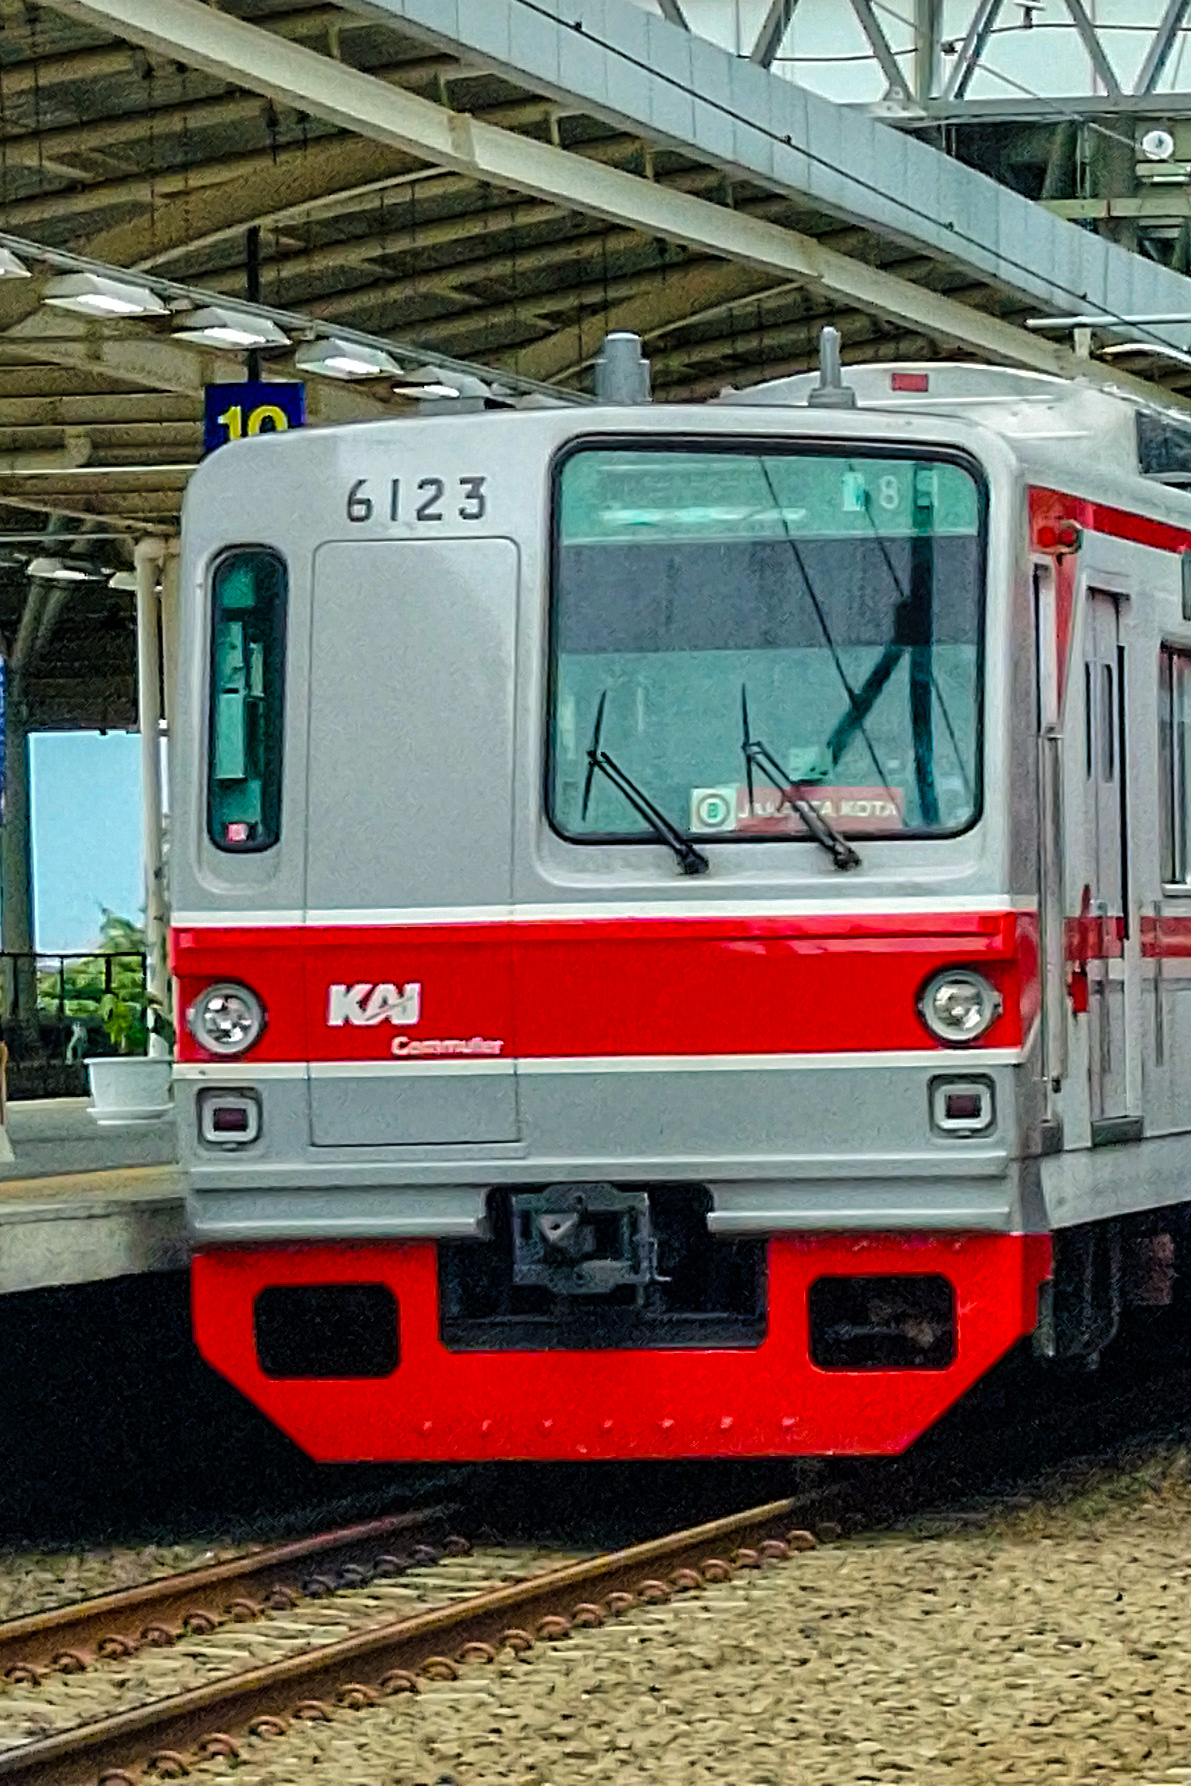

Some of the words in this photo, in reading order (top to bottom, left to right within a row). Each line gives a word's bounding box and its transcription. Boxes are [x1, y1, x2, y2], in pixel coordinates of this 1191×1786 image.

[217, 405, 288, 441] 10
[347, 476, 486, 522] 6123
[327, 982, 421, 1026] KAI
